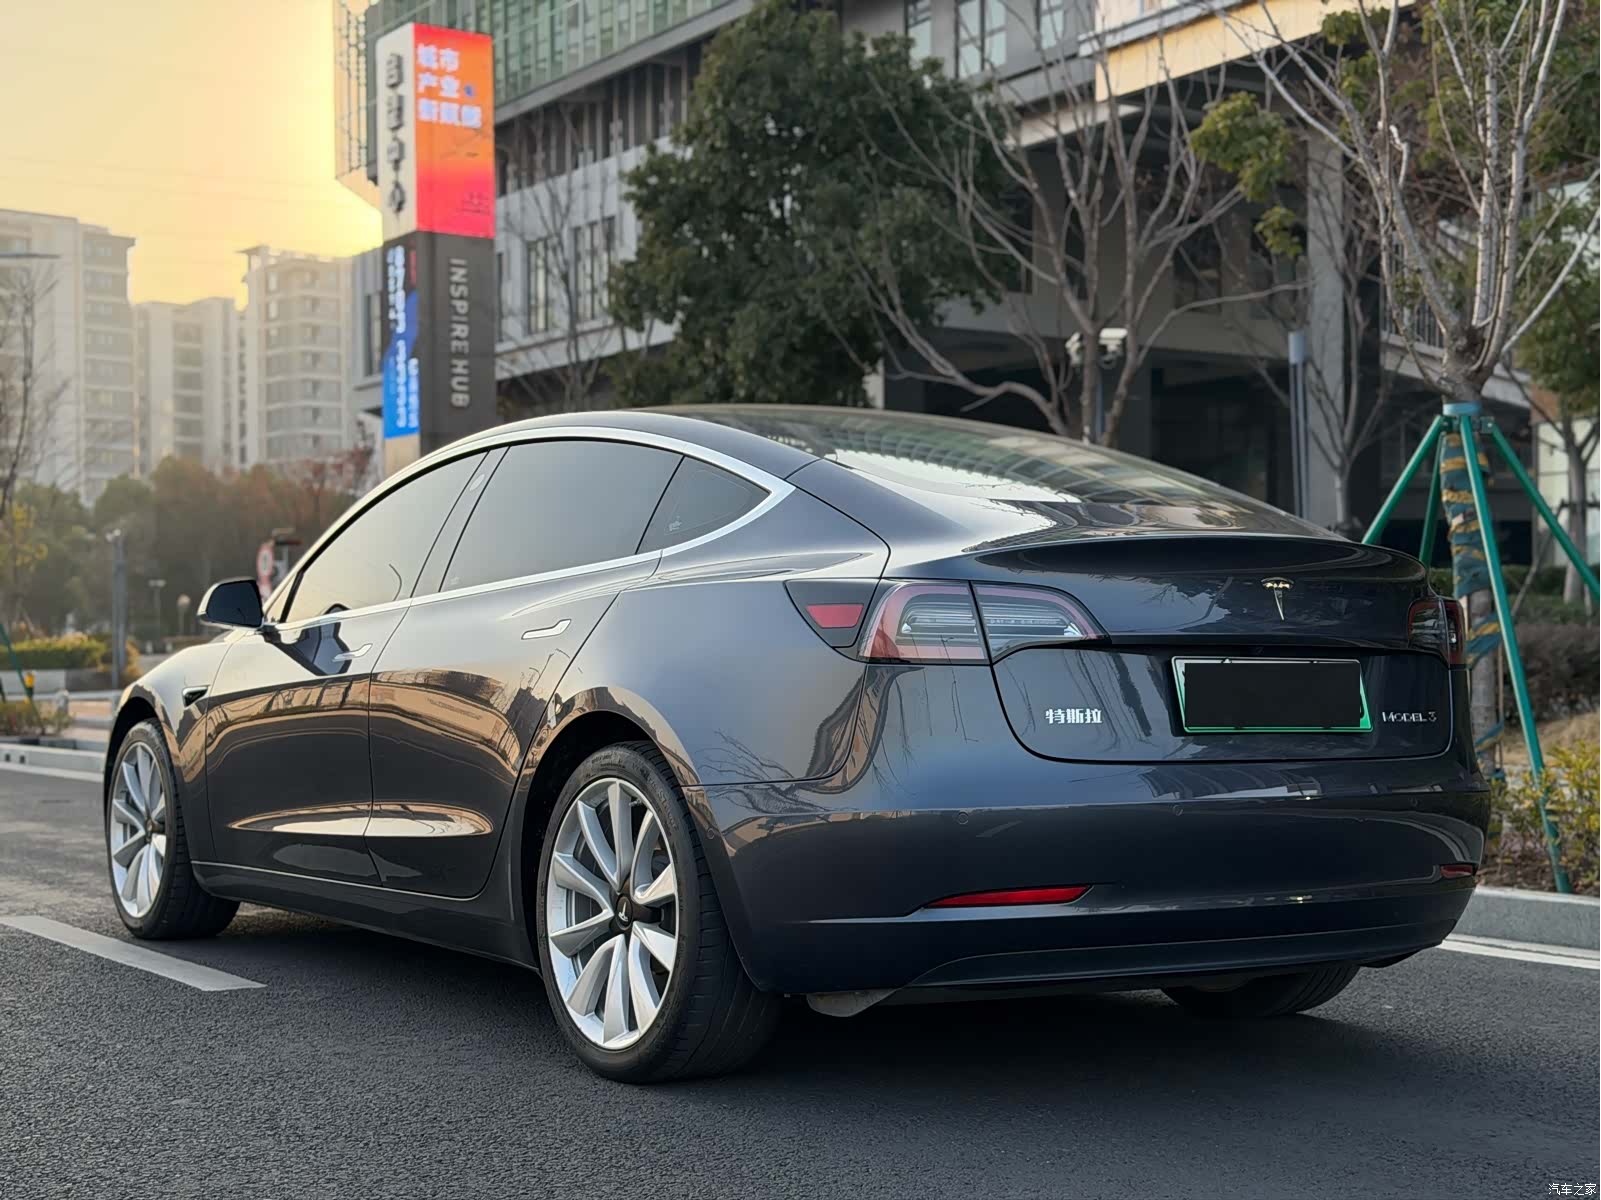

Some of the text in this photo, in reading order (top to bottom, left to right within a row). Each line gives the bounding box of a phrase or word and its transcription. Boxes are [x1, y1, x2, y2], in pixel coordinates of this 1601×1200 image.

[450, 258, 470, 407] INSPIRE HUB
[1045, 708, 1102, 724] 特斯拉
[1382, 711, 1437, 722] MODEL 3
